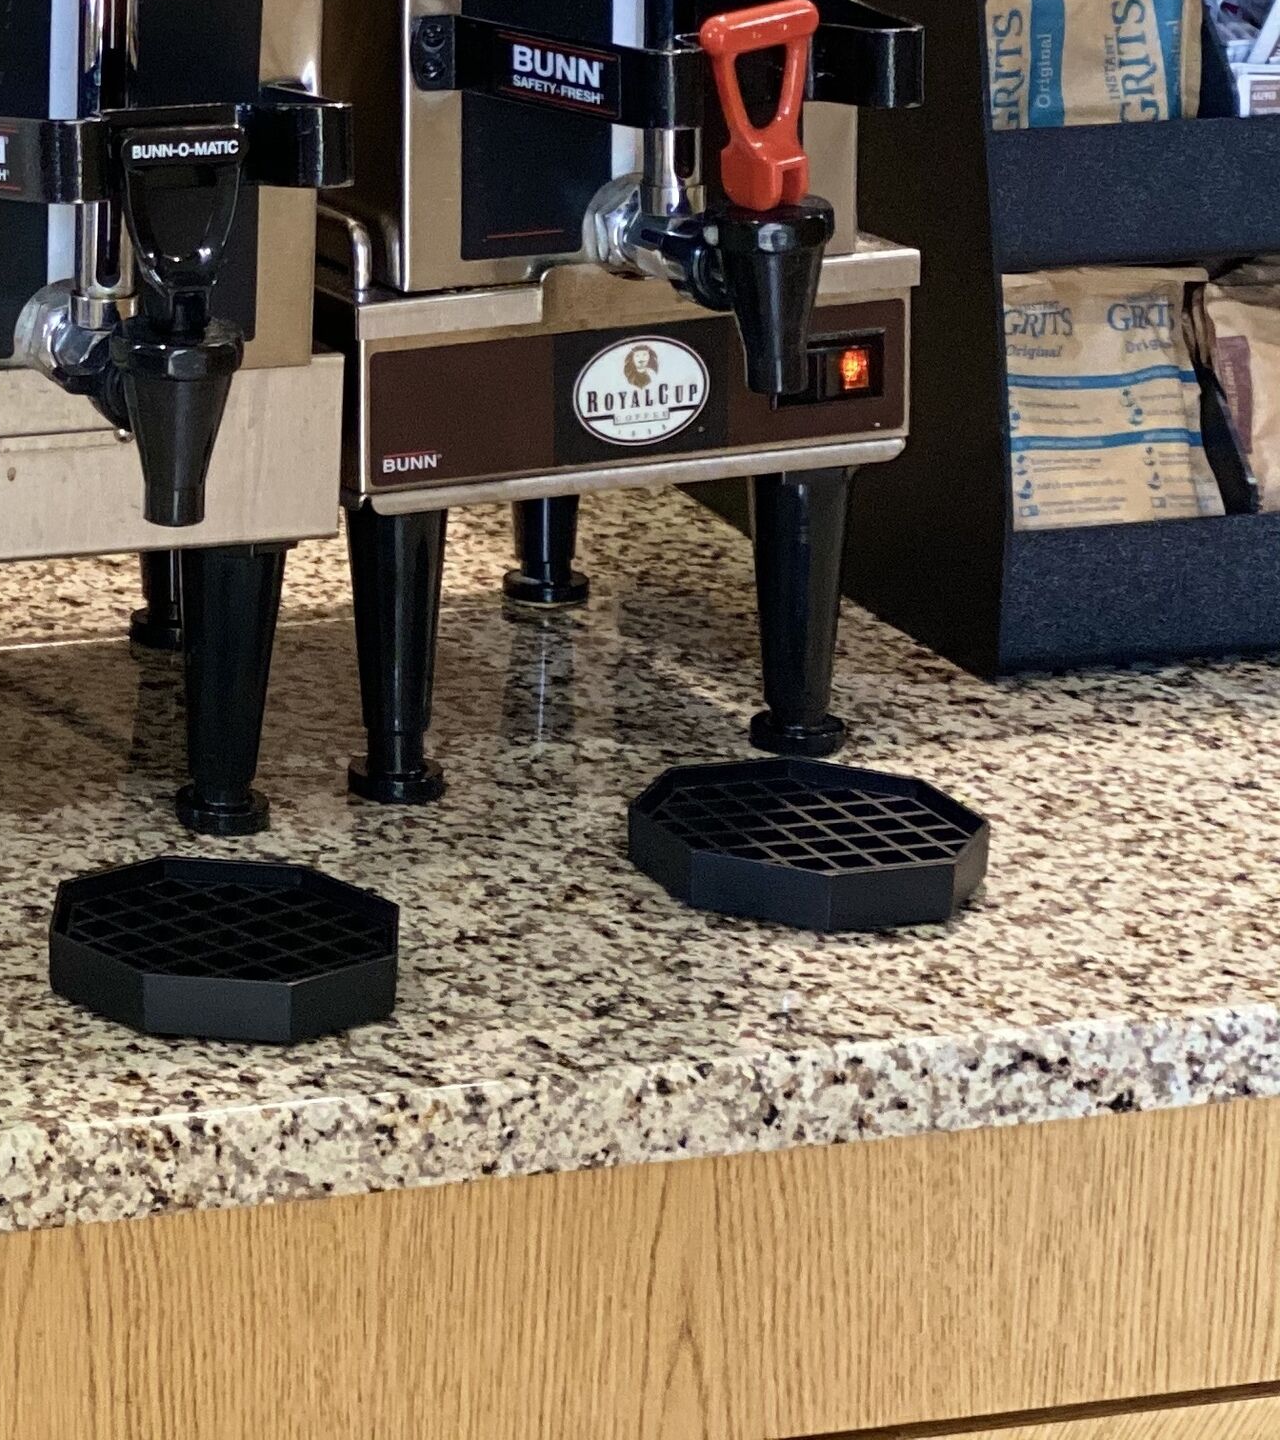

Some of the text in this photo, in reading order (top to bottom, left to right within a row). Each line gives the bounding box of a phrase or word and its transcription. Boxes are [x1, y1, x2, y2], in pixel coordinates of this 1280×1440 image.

[512, 44, 601, 89] BUNN
[1037, 34, 1053, 108] Original
[131, 140, 239, 160] BUNN-O-MATIC
[1004, 307, 1073, 337] GRITS
[383, 454, 437, 474] BUNN
